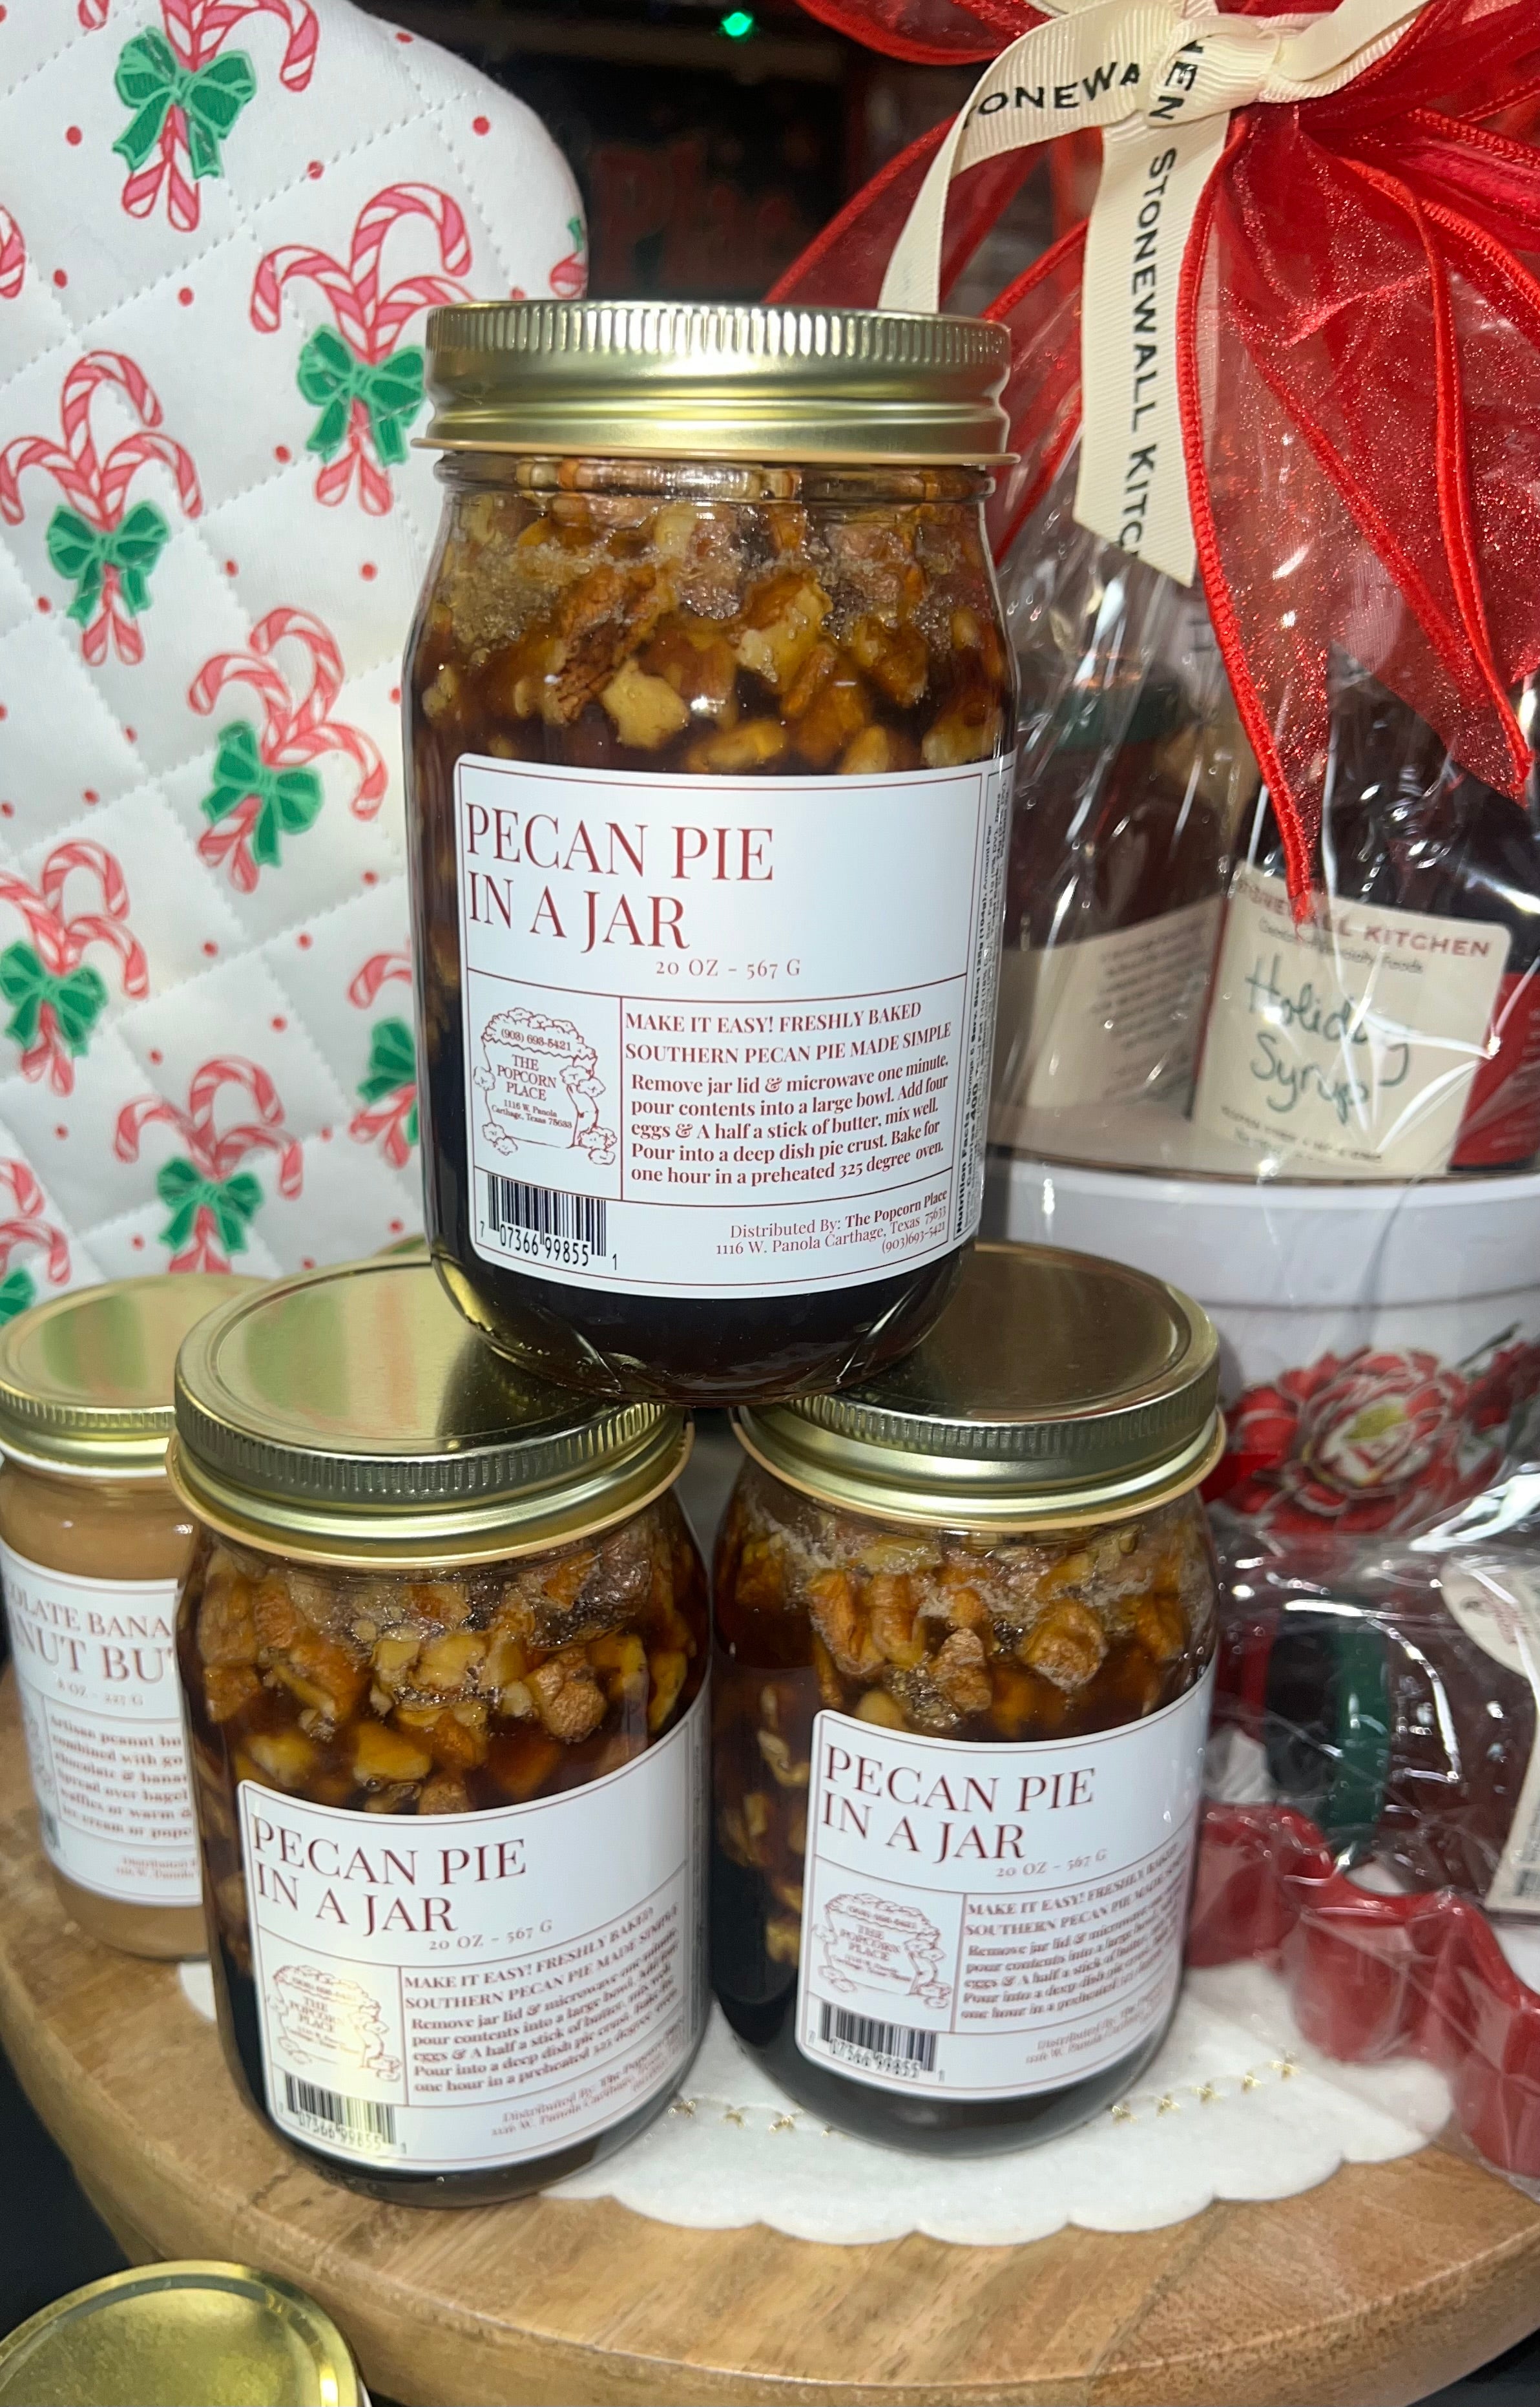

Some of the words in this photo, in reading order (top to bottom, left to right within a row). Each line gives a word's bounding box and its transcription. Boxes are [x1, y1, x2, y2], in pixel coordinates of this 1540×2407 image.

[1132, 147, 1177, 433] STONEWALL
[1119, 443, 1158, 558] KITC
[465, 803, 648, 877] PECAN
[671, 826, 773, 881] PIE
[468, 870, 514, 929] IN
[529, 886, 567, 938] A
[581, 890, 689, 952] JAR
[1364, 926, 1492, 958] KITCHEN
[656, 963, 679, 976] 20
[689, 958, 718, 976] OZ
[747, 960, 778, 979] 567
[787, 958, 800, 976] G
[626, 1013, 684, 1032] MAKE
[691, 1017, 711, 1032] IT
[717, 1016, 774, 1033] EASY!
[780, 1011, 864, 1032] FRESHLY
[868, 1002, 922, 1024] BAKED
[512, 1055, 539, 1071] THE
[625, 1044, 738, 1064] SOUTHERN
[745, 1046, 810, 1064] PECAN
[816, 1044, 845, 1060] PIE
[850, 1036, 899, 1057] MADE
[903, 1022, 952, 1048] SIMPLE
[497, 1065, 556, 1088] POPCORN
[506, 1082, 546, 1101] PLACE
[632, 1075, 703, 1093] Remove
[708, 1077, 732, 1095] jar
[738, 1077, 759, 1093] lid
[765, 1078, 782, 1092] &
[787, 1071, 874, 1091] microwave
[878, 1067, 902, 1082] one
[906, 1053, 948, 1077] minute.
[533, 1106, 557, 1117] Panola
[632, 1101, 674, 1115] pour
[680, 1101, 755, 1117] contents
[760, 1099, 794, 1115] into
[799, 1104, 807, 1114] a
[813, 1096, 852, 1113] large
[857, 1088, 894, 1107] bowl.
[897, 1082, 923, 1100] Add
[926, 1075, 948, 1093] four
[526, 1113, 546, 1124] Texas
[632, 1124, 671, 1140] eggs
[675, 1124, 693, 1138] &
[697, 1126, 710, 1138] A
[715, 1123, 750, 1139] half
[754, 1127, 763, 1138] a
[767, 1121, 807, 1137] stick
[812, 1120, 831, 1135] of
[832, 1115, 881, 1133] butter,
[885, 1106, 910, 1124] mix
[913, 1097, 938, 1117] well.
[632, 1144, 675, 1159] Pour
[680, 1146, 714, 1161] into
[719, 1150, 729, 1161] a
[733, 1146, 775, 1164] deep
[780, 1142, 815, 1160] dish
[819, 1140, 843, 1159] pie
[848, 1135, 887, 1153] crust.
[891, 1126, 921, 1146] Bake
[924, 1120, 941, 1135] for
[632, 1169, 662, 1181] one
[668, 1167, 710, 1184] hour
[715, 1168, 733, 1184] in
[738, 1172, 747, 1184] a
[752, 1163, 835, 1186] preheated
[840, 1163, 863, 1179] 325
[867, 1150, 911, 1173] degree
[915, 1141, 944, 1161] oven.
[956, 1163, 967, 1233] Nutrition
[962, 1113, 970, 1158] Facts
[716, 1242, 744, 1254] 1116
[749, 1239, 767, 1254] W.
[773, 1235, 820, 1252] Panola
[826, 1225, 886, 1247] Carthage,
[890, 1217, 920, 1235] Texas
[925, 1206, 946, 1225] 75633
[731, 1219, 816, 1238] Distributed
[821, 1219, 841, 1234] By:
[845, 1213, 870, 1228] The
[874, 1200, 921, 1222] Popcorn
[924, 1189, 947, 1206] Place
[481, 1221, 484, 1237] 7
[500, 1224, 539, 1256] 07366
[545, 1237, 589, 1266] 99855
[612, 1254, 618, 1270] 1
[88, 1611, 172, 1639] BANA
[101, 1645, 174, 1684] BU
[824, 1743, 999, 1813] PECAN
[1018, 1767, 1096, 1813] PIE
[822, 1789, 871, 1840] IN
[886, 1816, 922, 1853] A
[934, 1823, 1026, 1864] JAR
[251, 1814, 418, 1886] PECAN
[439, 1838, 526, 1886] PIE
[997, 1867, 1017, 1876] 20
[1023, 1862, 1048, 1875] OZ
[255, 1859, 299, 1911] IN
[315, 1888, 349, 1924] A
[363, 1895, 458, 1937] JAR
[968, 1904, 1017, 1915] MAKE
[1021, 1901, 1039, 1913] IT
[1041, 1891, 1085, 1911] EASY!
[429, 1940, 450, 1950] 20
[457, 1935, 483, 1949] OZ
[507, 1928, 533, 1944] 567
[540, 1920, 552, 1932] G
[965, 1918, 1056, 1935] SOUTHERN
[406, 1977, 456, 1988] MAKE
[461, 1975, 479, 1986] IT
[484, 1964, 532, 1984] EASY!
[406, 1992, 503, 2009] SOUTHERN
[508, 1975, 563, 2001] PECAN
[412, 2018, 474, 2030] Remove
[478, 2015, 499, 2027] jar
[503, 2007, 523, 2022] lid
